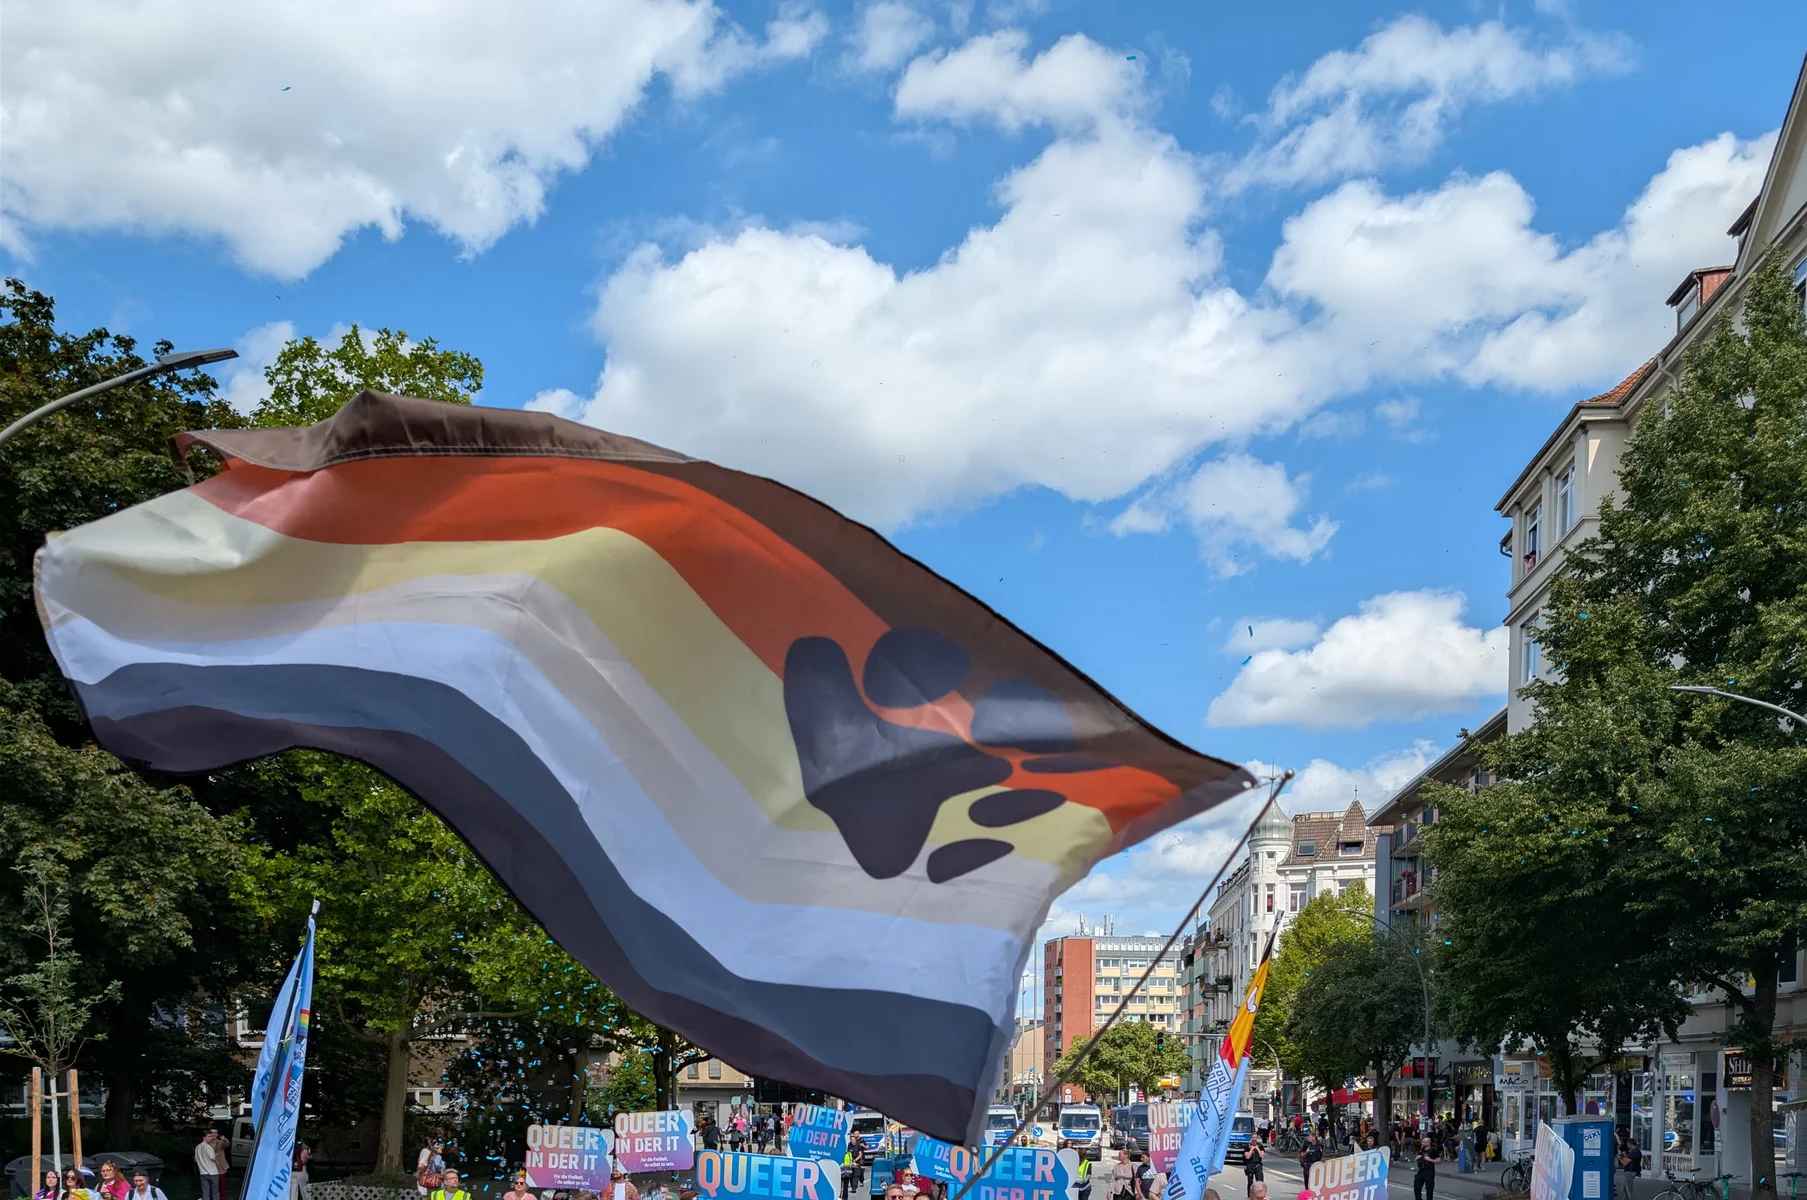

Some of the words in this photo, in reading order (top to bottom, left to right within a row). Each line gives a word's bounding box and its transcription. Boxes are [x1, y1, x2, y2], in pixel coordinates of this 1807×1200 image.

[615, 1111, 679, 1138] QUEER
[794, 1102, 845, 1130] QUEER
[1147, 1103, 1191, 1133] QUEER
[527, 1125, 599, 1151] QUEER
[616, 1138, 630, 1154] IN
[635, 1137, 663, 1153] DER
[666, 1136, 680, 1151] IT
[789, 1127, 804, 1143] IN
[806, 1130, 828, 1147] DER
[829, 1133, 840, 1148] IT
[916, 1139, 930, 1157] IN
[933, 1145, 950, 1162] DE
[1149, 1134, 1160, 1151] IN
[1163, 1132, 1181, 1150] DER
[526, 1151, 543, 1168] IN
[548, 1153, 578, 1169] DER
[584, 1154, 598, 1171] IT
[950, 1145, 1055, 1183] QUEER
[699, 1151, 819, 1200] QUEER
[1308, 1152, 1381, 1197] QUEER
